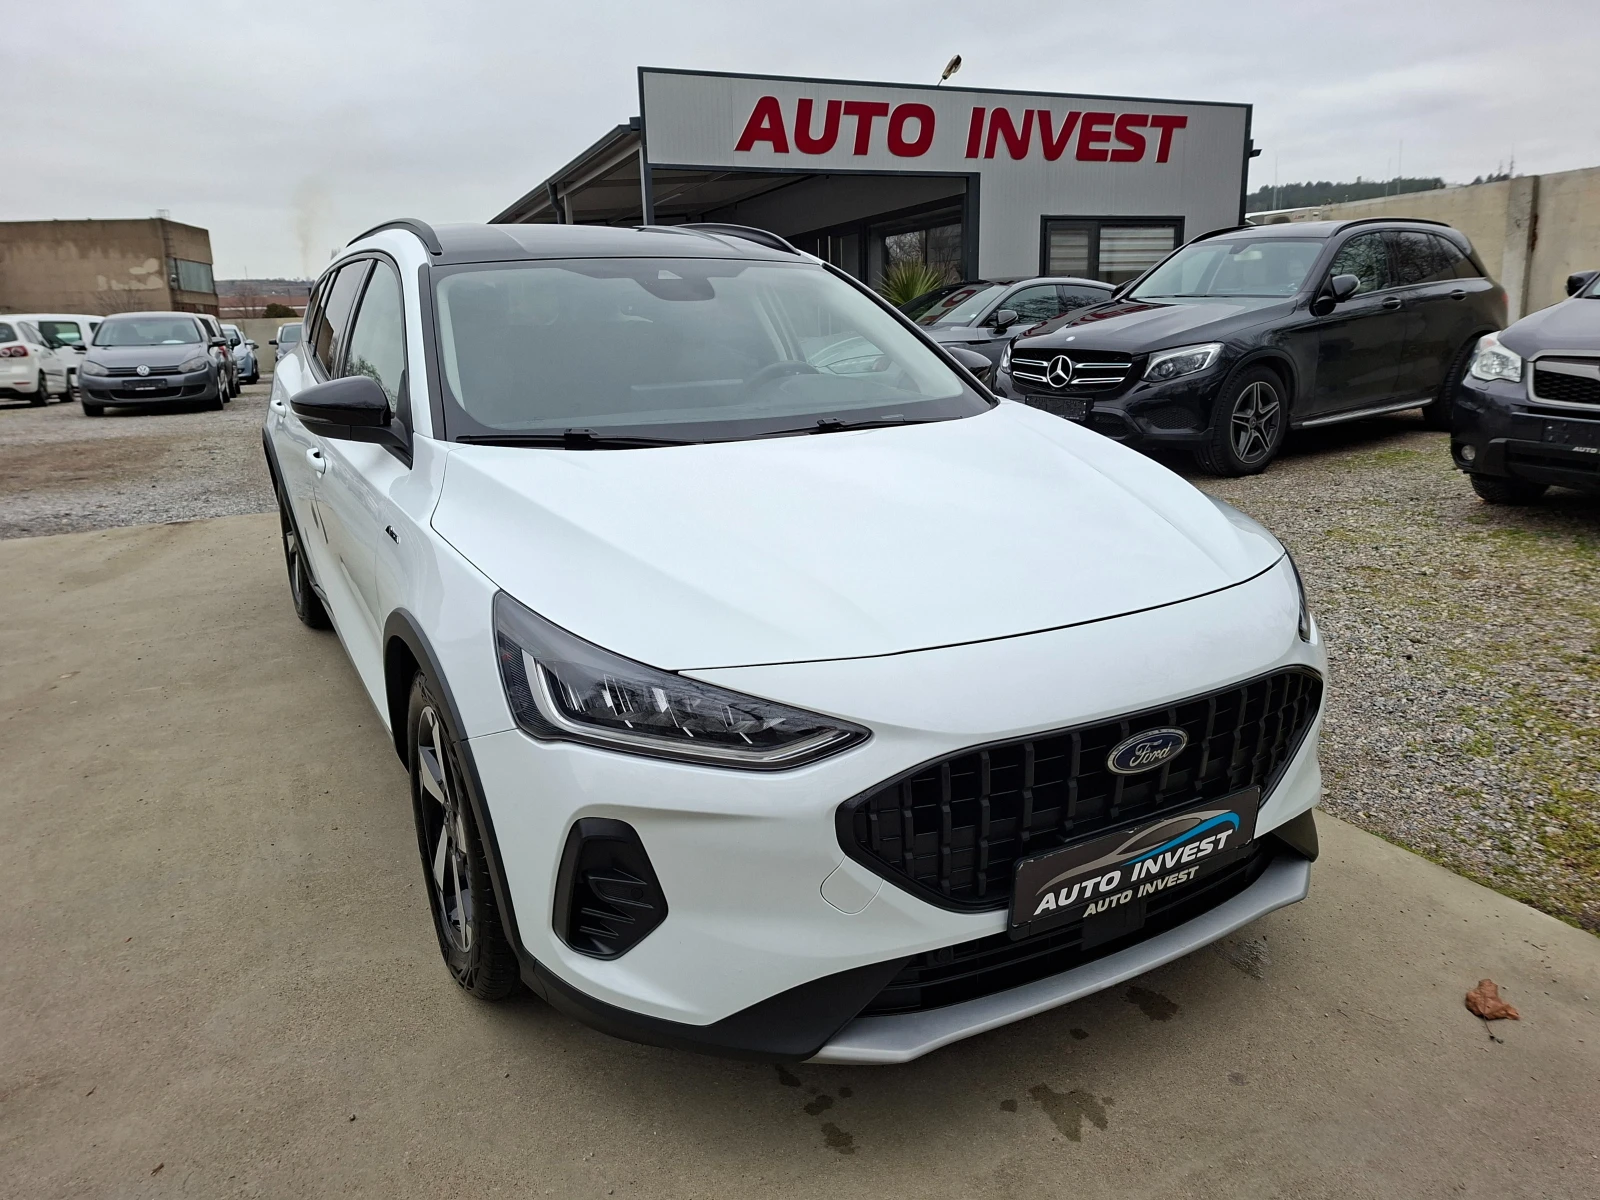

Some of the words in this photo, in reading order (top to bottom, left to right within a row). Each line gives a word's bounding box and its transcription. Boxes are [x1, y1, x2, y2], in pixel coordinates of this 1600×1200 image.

[734, 95, 936, 158] AUTO
[965, 106, 1188, 163] INVEST
[1572, 446, 1598, 454] AUTO
[1129, 741, 1172, 767] Ford
[1034, 871, 1121, 915] AUTO
[1131, 829, 1233, 882] INVEST
[1083, 890, 1133, 918] AUTO
[1137, 865, 1199, 898] INVEST
